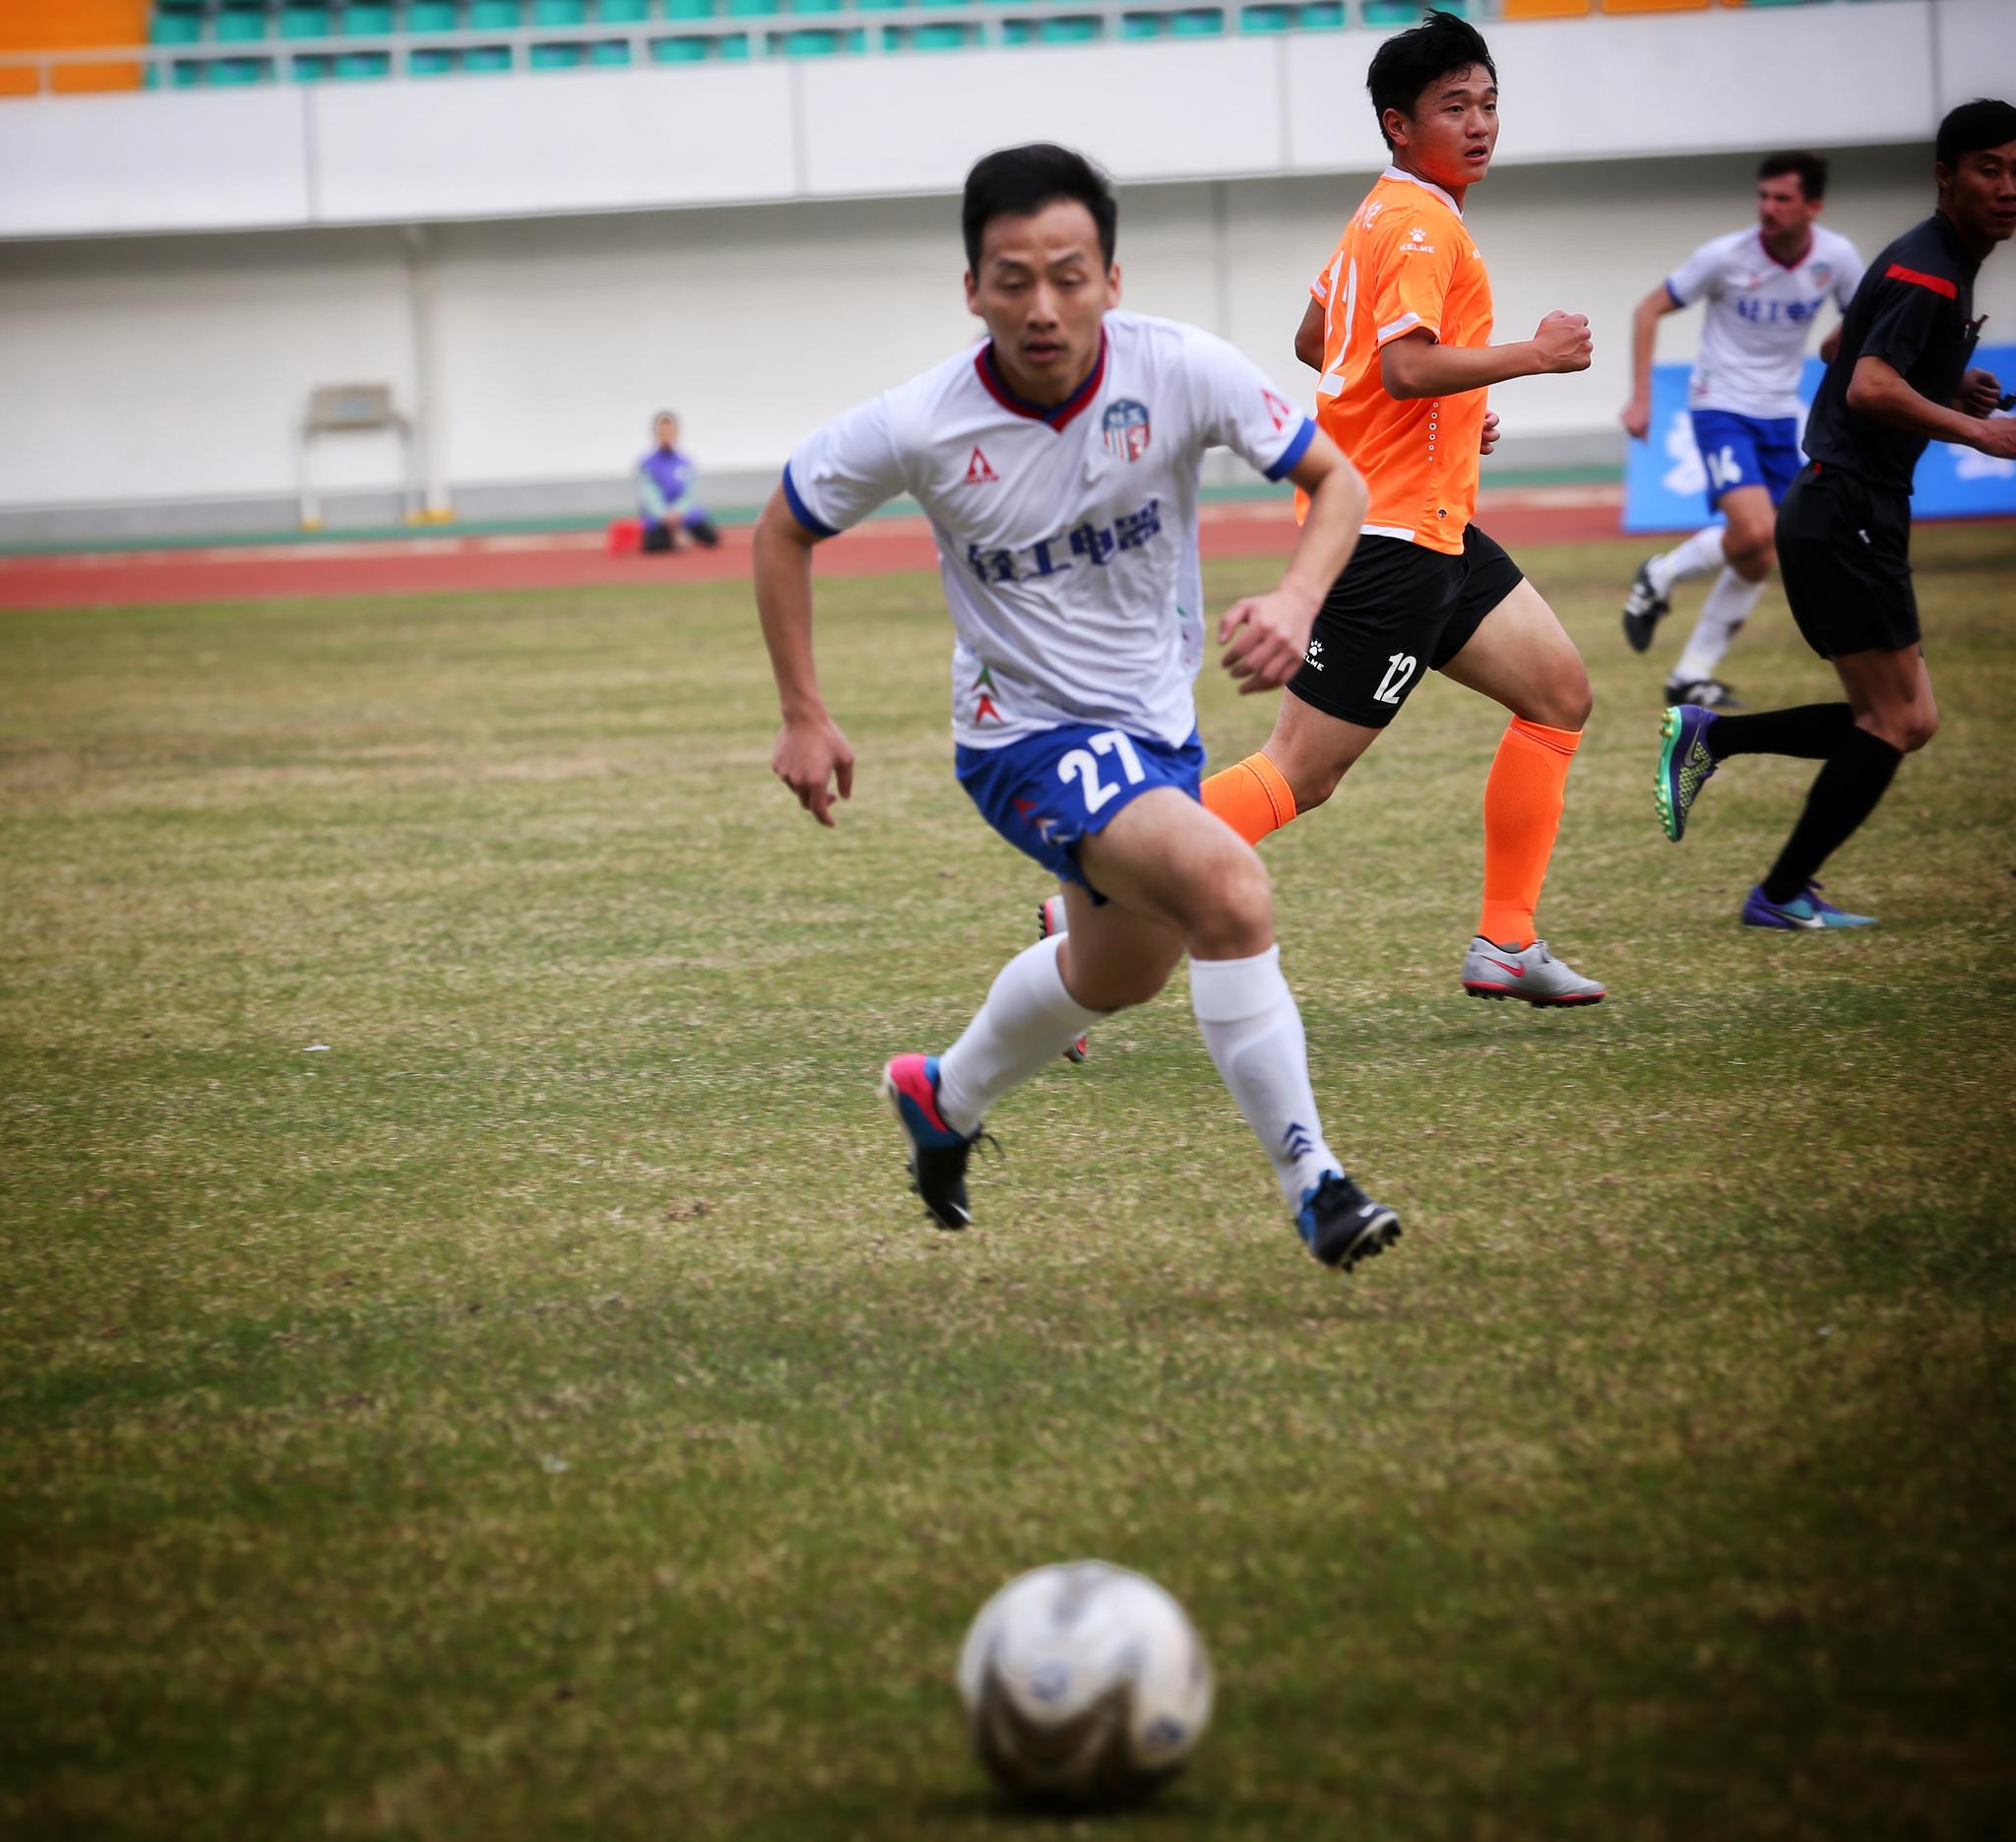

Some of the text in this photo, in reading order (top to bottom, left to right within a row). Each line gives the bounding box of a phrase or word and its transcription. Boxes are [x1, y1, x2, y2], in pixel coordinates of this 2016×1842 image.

[1400, 243, 1434, 254] KELME
[1301, 651, 1325, 671] ELME
[1373, 652, 1418, 704] 12
[1057, 730, 1146, 815] 27
